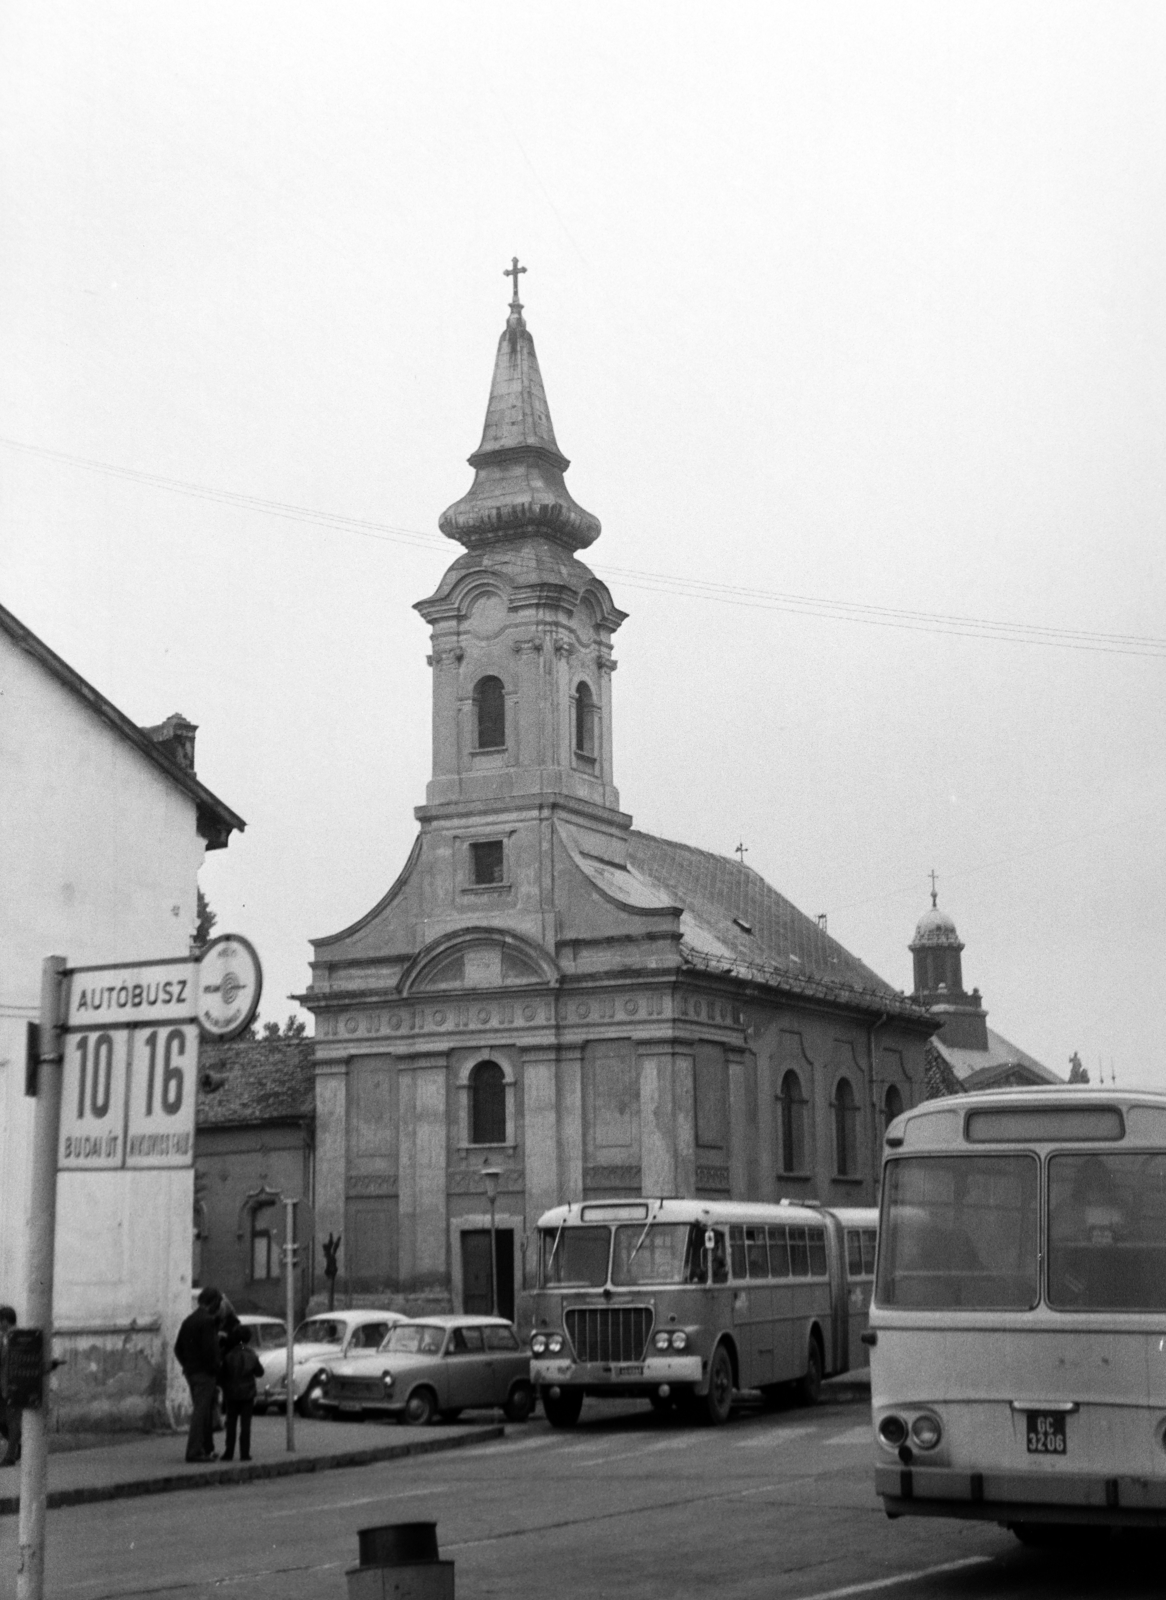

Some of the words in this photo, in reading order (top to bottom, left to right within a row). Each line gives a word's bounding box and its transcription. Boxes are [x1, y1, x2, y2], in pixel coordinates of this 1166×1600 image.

[76, 979, 188, 1012] AUTÓBUSZ
[76, 1033, 114, 1120] 10
[144, 1028, 187, 1118] 16
[64, 1135, 103, 1159] BUDAI
[1037, 1416, 1054, 1433] GC
